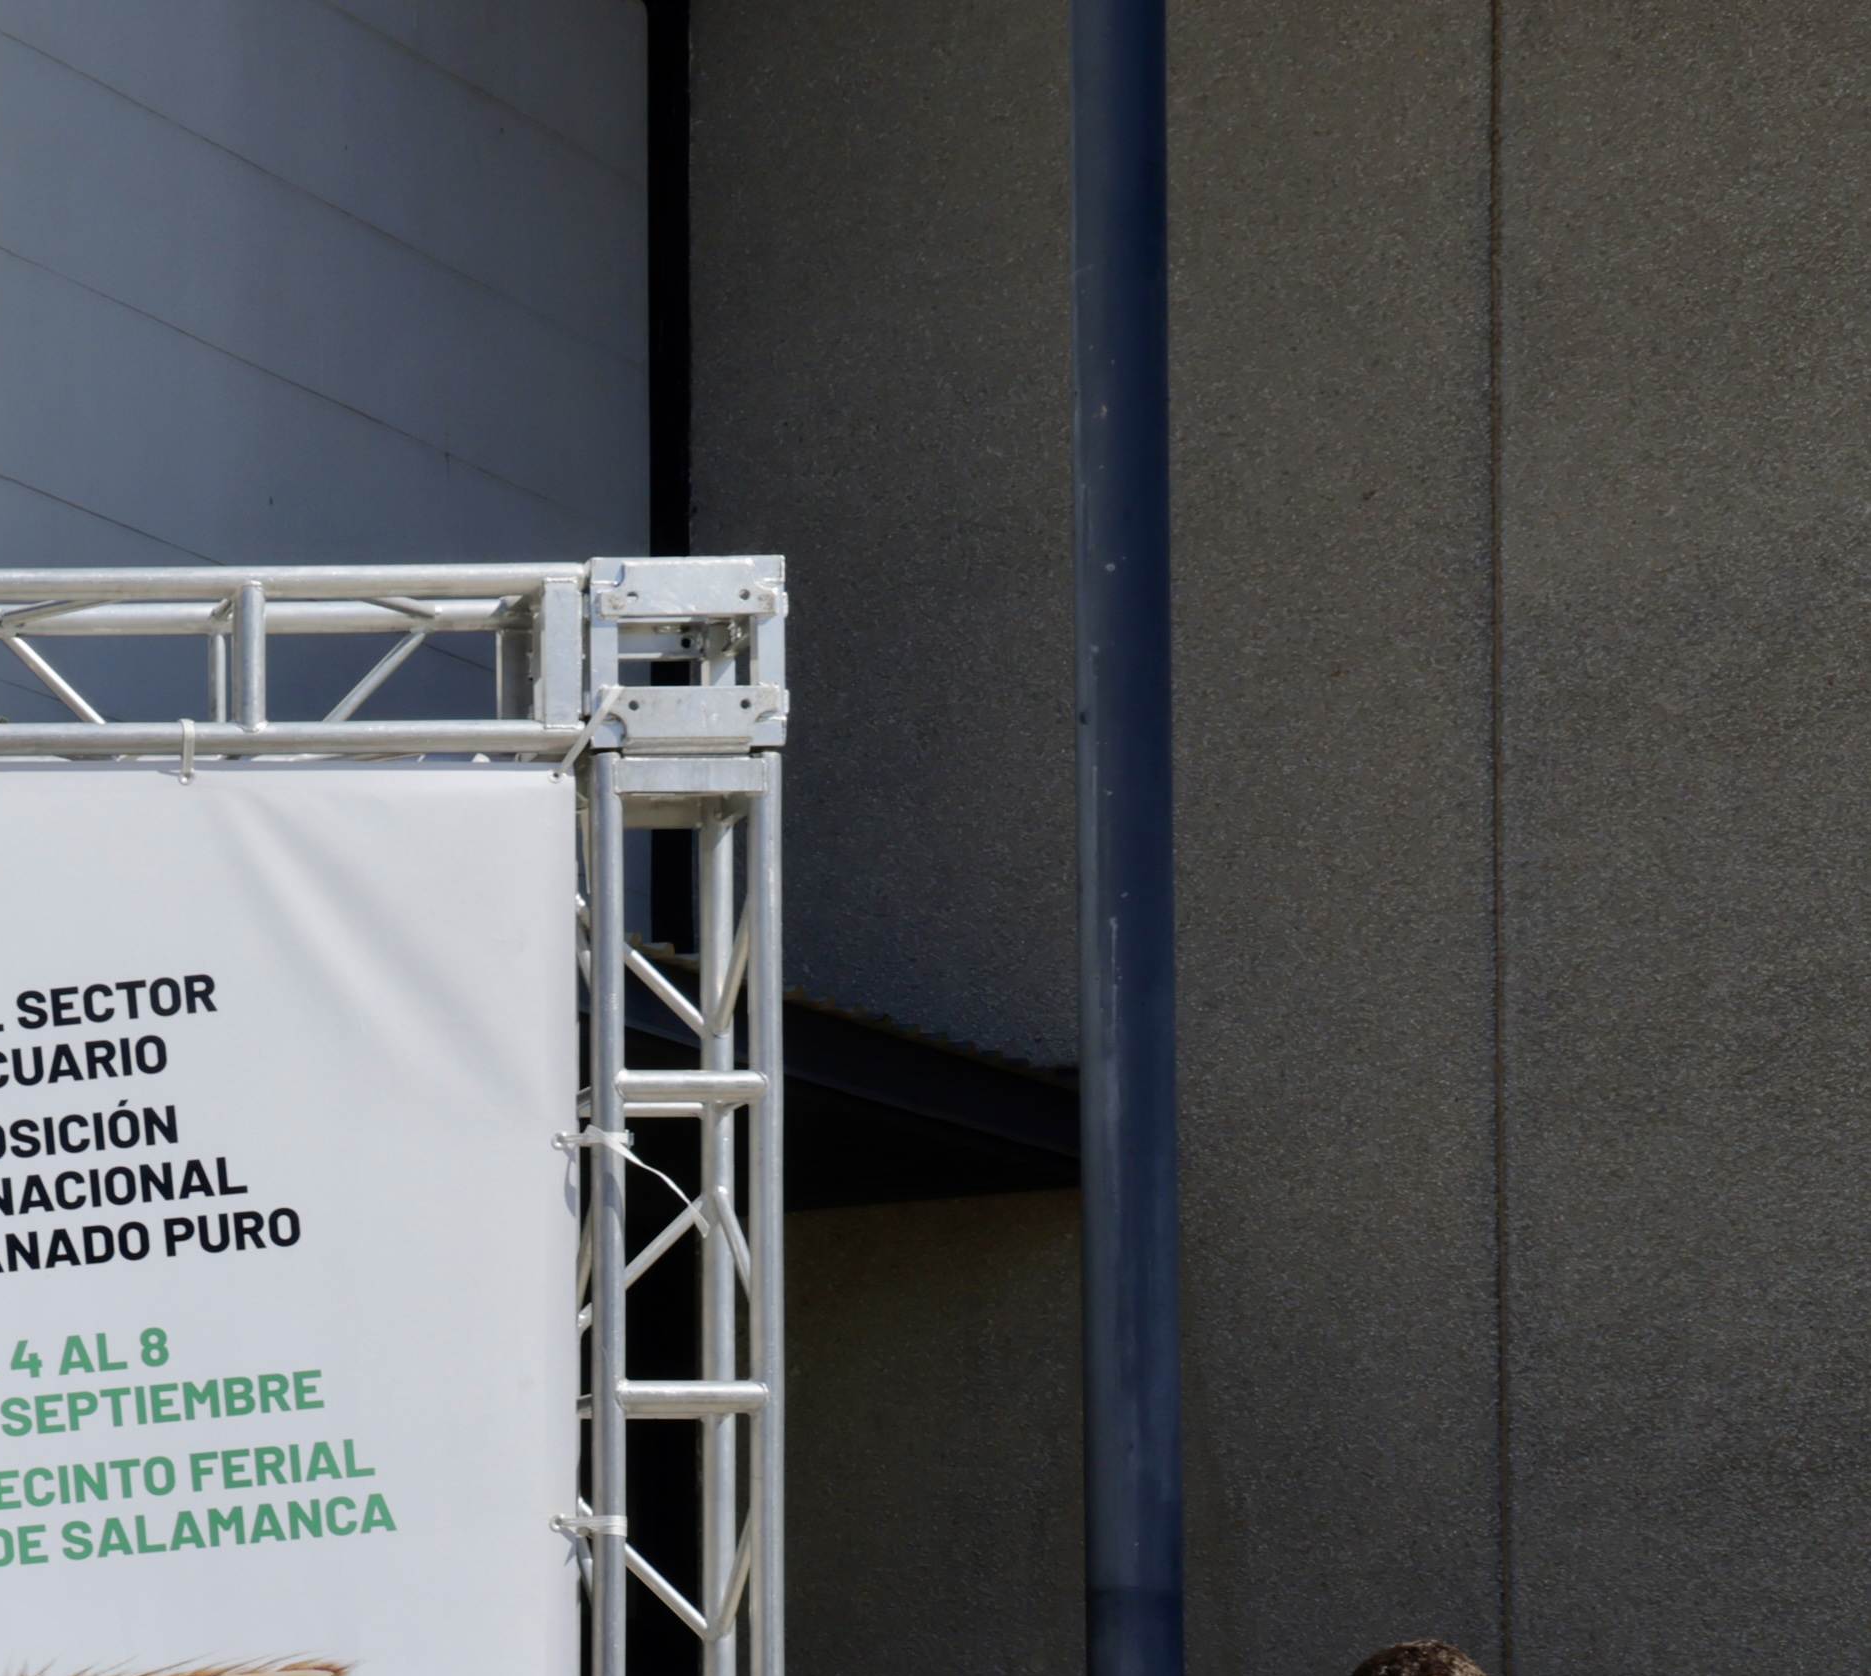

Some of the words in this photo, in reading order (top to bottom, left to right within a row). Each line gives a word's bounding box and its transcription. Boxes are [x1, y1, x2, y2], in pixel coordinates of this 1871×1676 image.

[16, 974, 217, 1030] SECTOR
[163, 1208, 301, 1257] PURO
[11, 1340, 42, 1378] 4
[59, 1333, 128, 1375] AL
[140, 1328, 169, 1367] 8
[1, 1370, 324, 1437] SEPTIEMBRE
[190, 1439, 375, 1492] FERIAL
[62, 1493, 397, 1560] SALAMANCA
